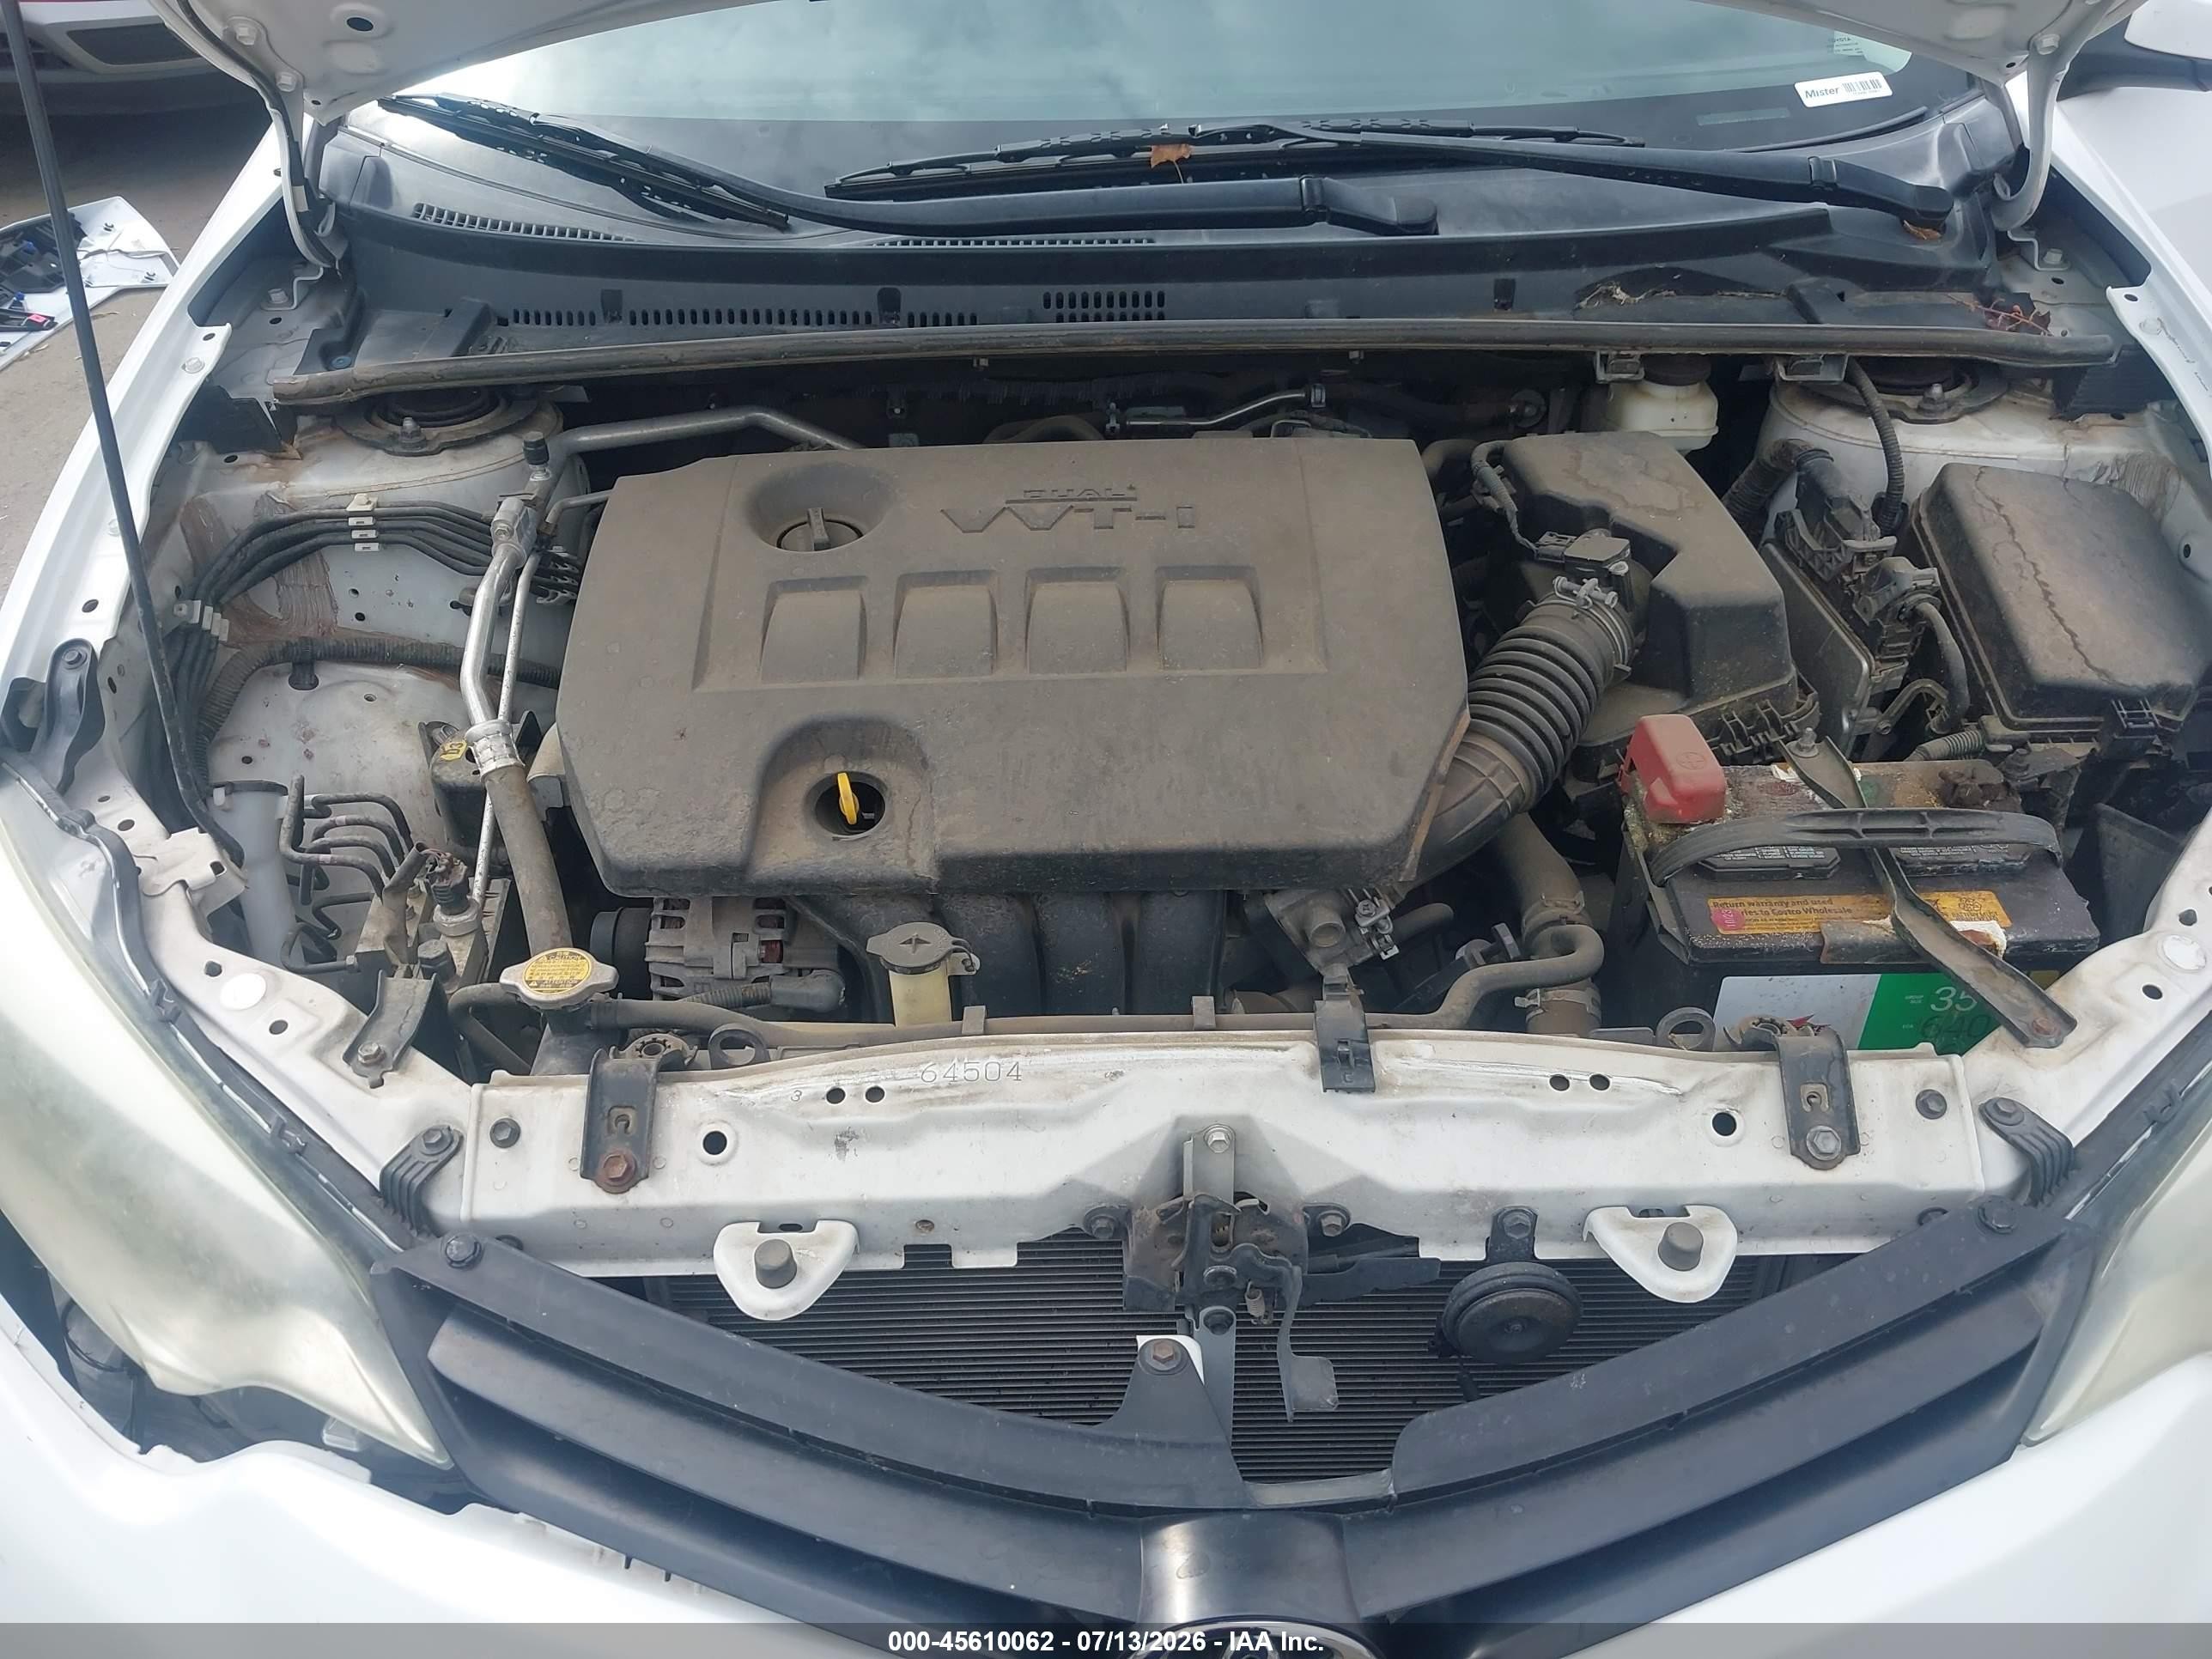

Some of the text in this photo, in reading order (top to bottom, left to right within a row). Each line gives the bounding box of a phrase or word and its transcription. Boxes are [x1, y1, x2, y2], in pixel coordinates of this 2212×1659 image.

[1804, 87, 1840, 99] Mister
[1747, 900, 1789, 908] warranty
[1803, 906, 1852, 915] Wholesale
[1930, 986, 1978, 1012] 35
[921, 1061, 1023, 1084] 64504
[791, 1090, 803, 1103] 3
